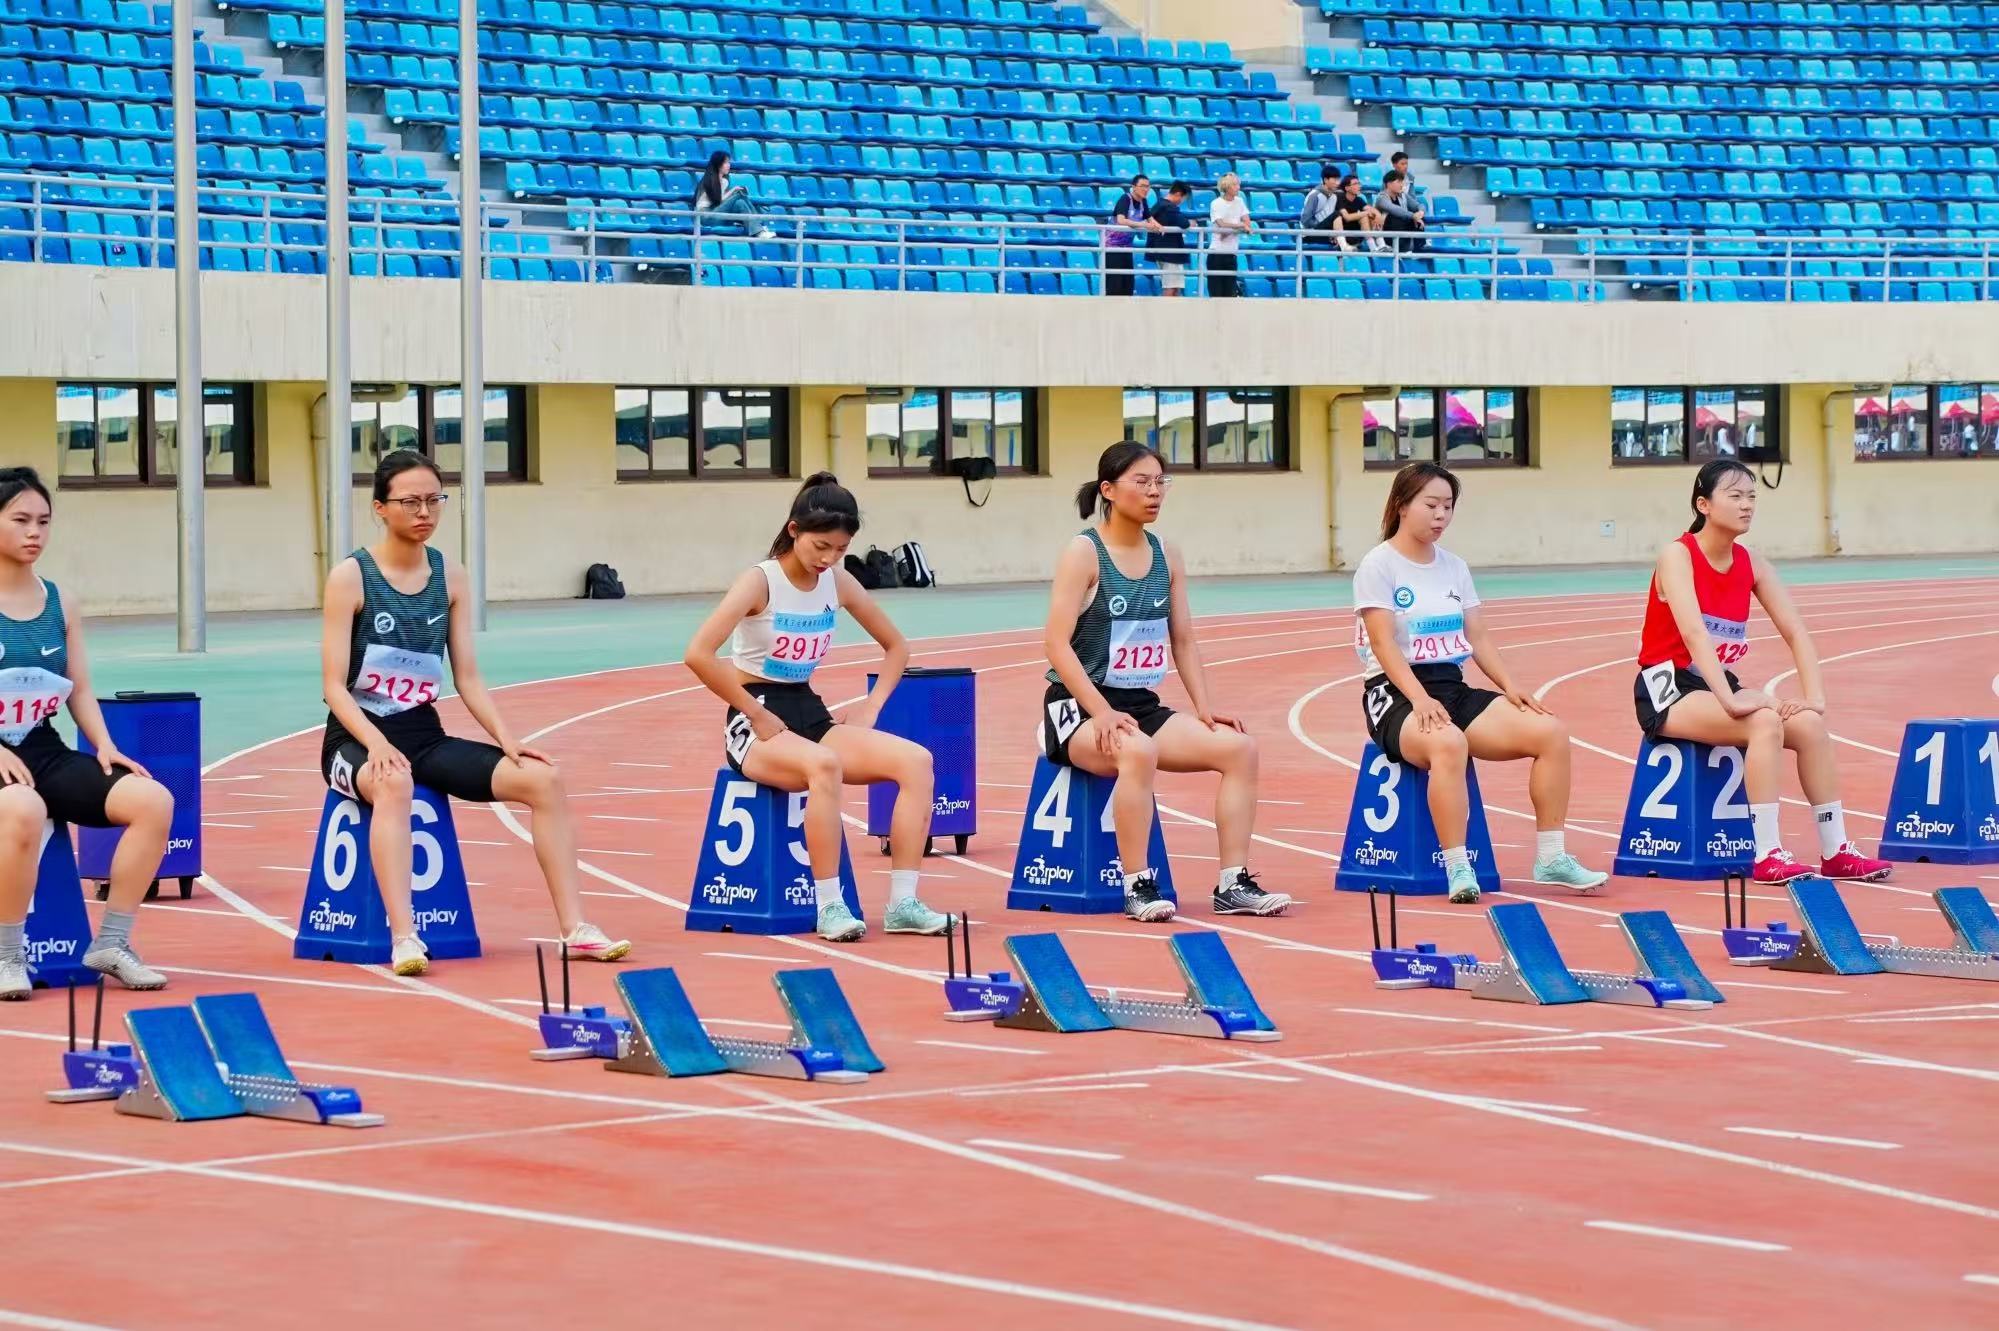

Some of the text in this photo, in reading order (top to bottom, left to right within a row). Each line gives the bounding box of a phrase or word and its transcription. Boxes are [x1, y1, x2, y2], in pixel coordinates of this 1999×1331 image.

[772, 634, 831, 661] 2912
[1114, 644, 1164, 669] 2123
[1413, 634, 1470, 661] 2914
[361, 673, 434, 705] 2125
[1058, 697, 1077, 730] 4
[1651, 669, 1676, 705] 2
[1363, 754, 1401, 833] 3
[1639, 743, 1683, 819] 2
[1707, 746, 1750, 819] 2
[1915, 731, 1946, 805] 1
[1978, 731, 1999, 805] 1
[714, 781, 758, 866] 5
[1033, 767, 1072, 848] 4
[323, 799, 361, 891] 6
[411, 799, 444, 891] 6
